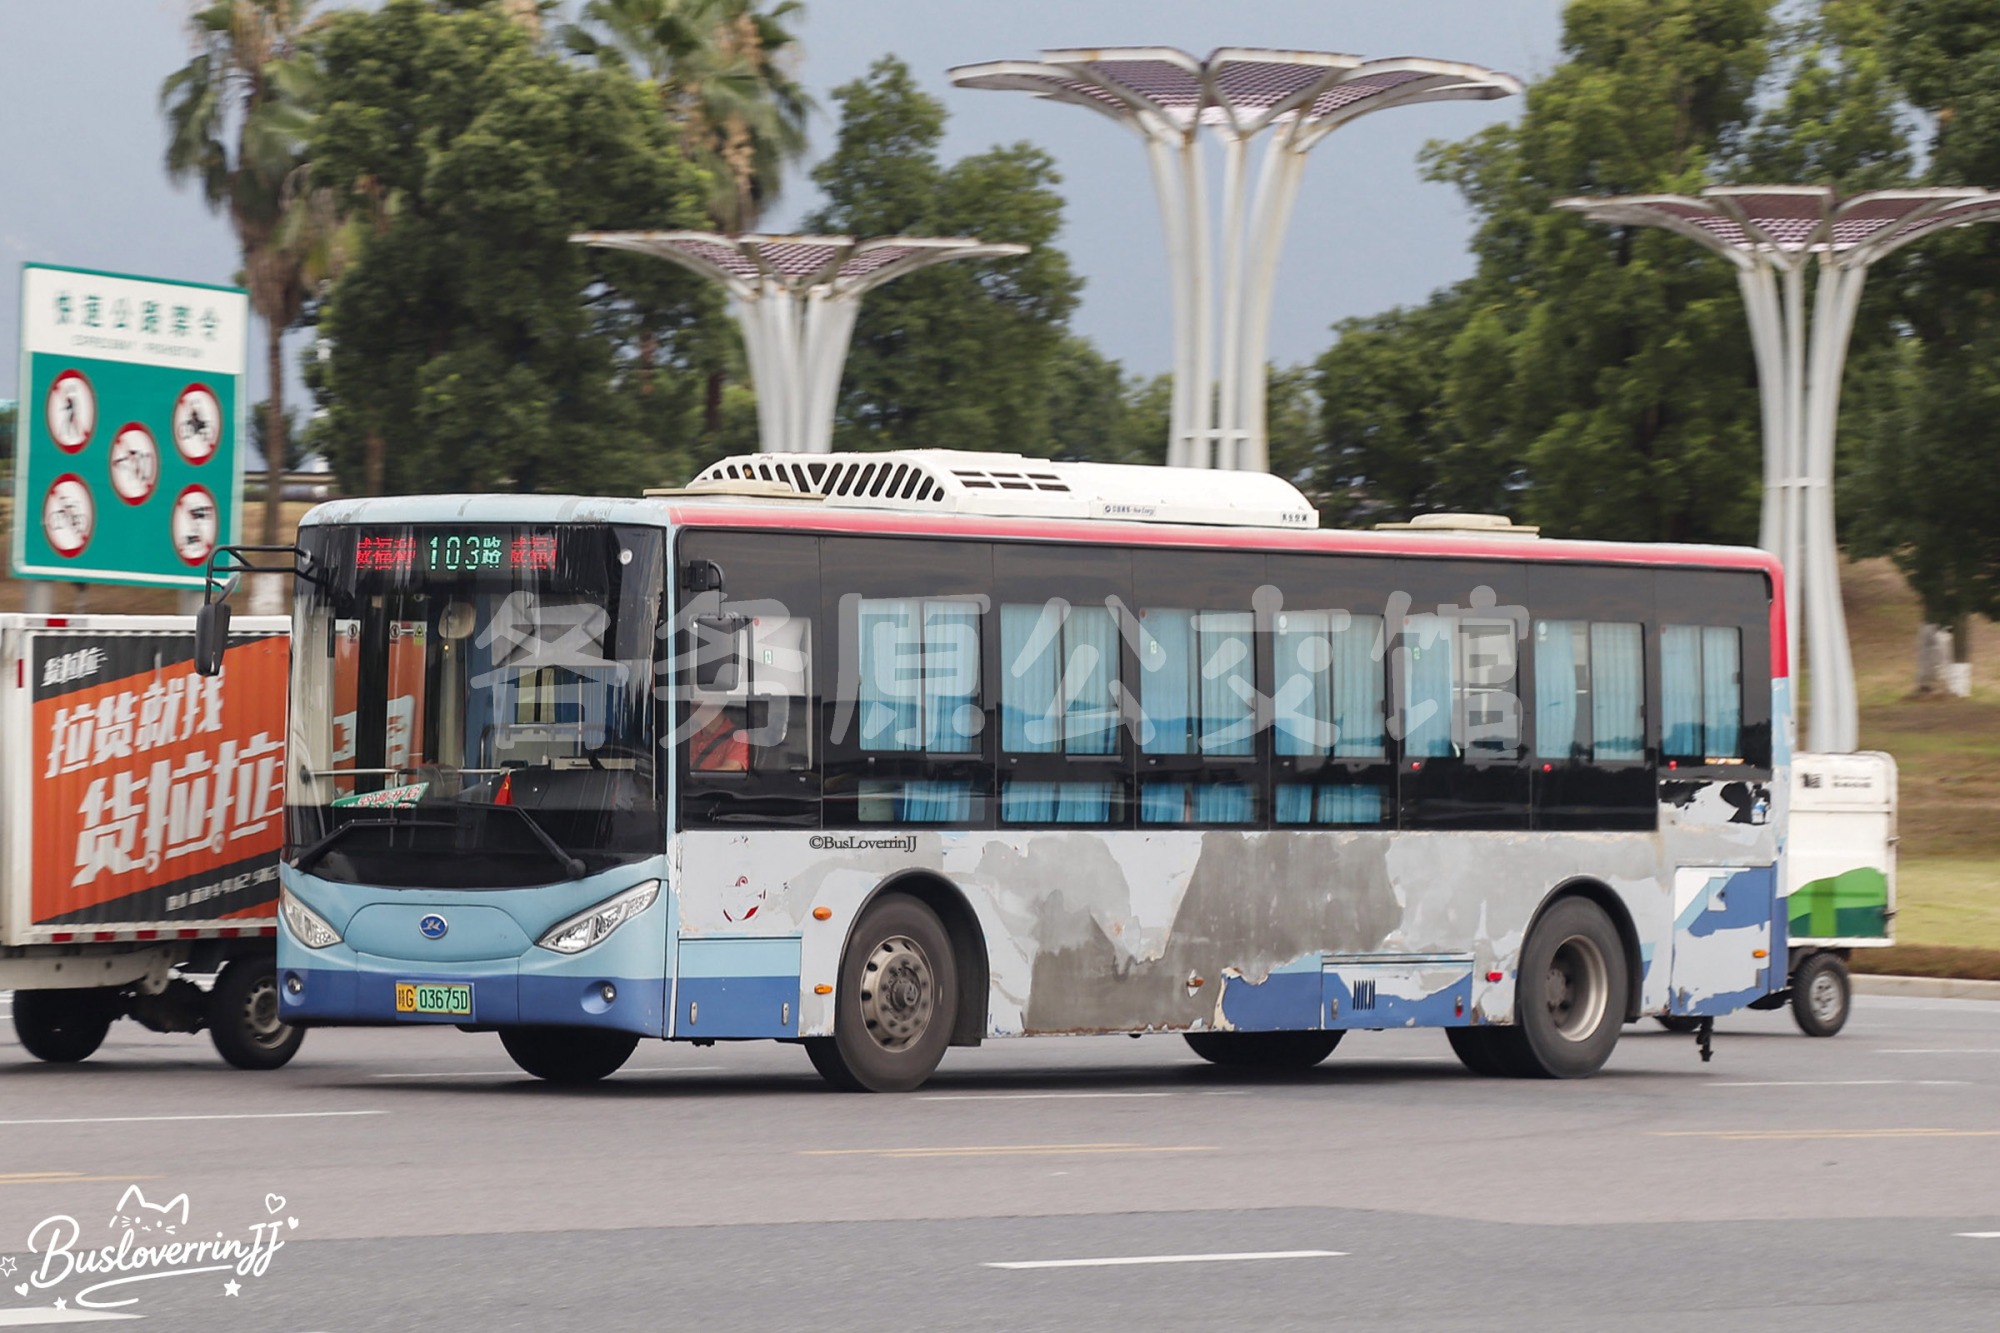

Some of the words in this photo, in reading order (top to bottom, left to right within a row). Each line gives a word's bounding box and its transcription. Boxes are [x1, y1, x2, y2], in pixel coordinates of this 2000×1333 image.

[430, 536, 502, 570] 103路
[44, 651, 226, 779] 拉货就找
[71, 731, 284, 888] 货拉拉
